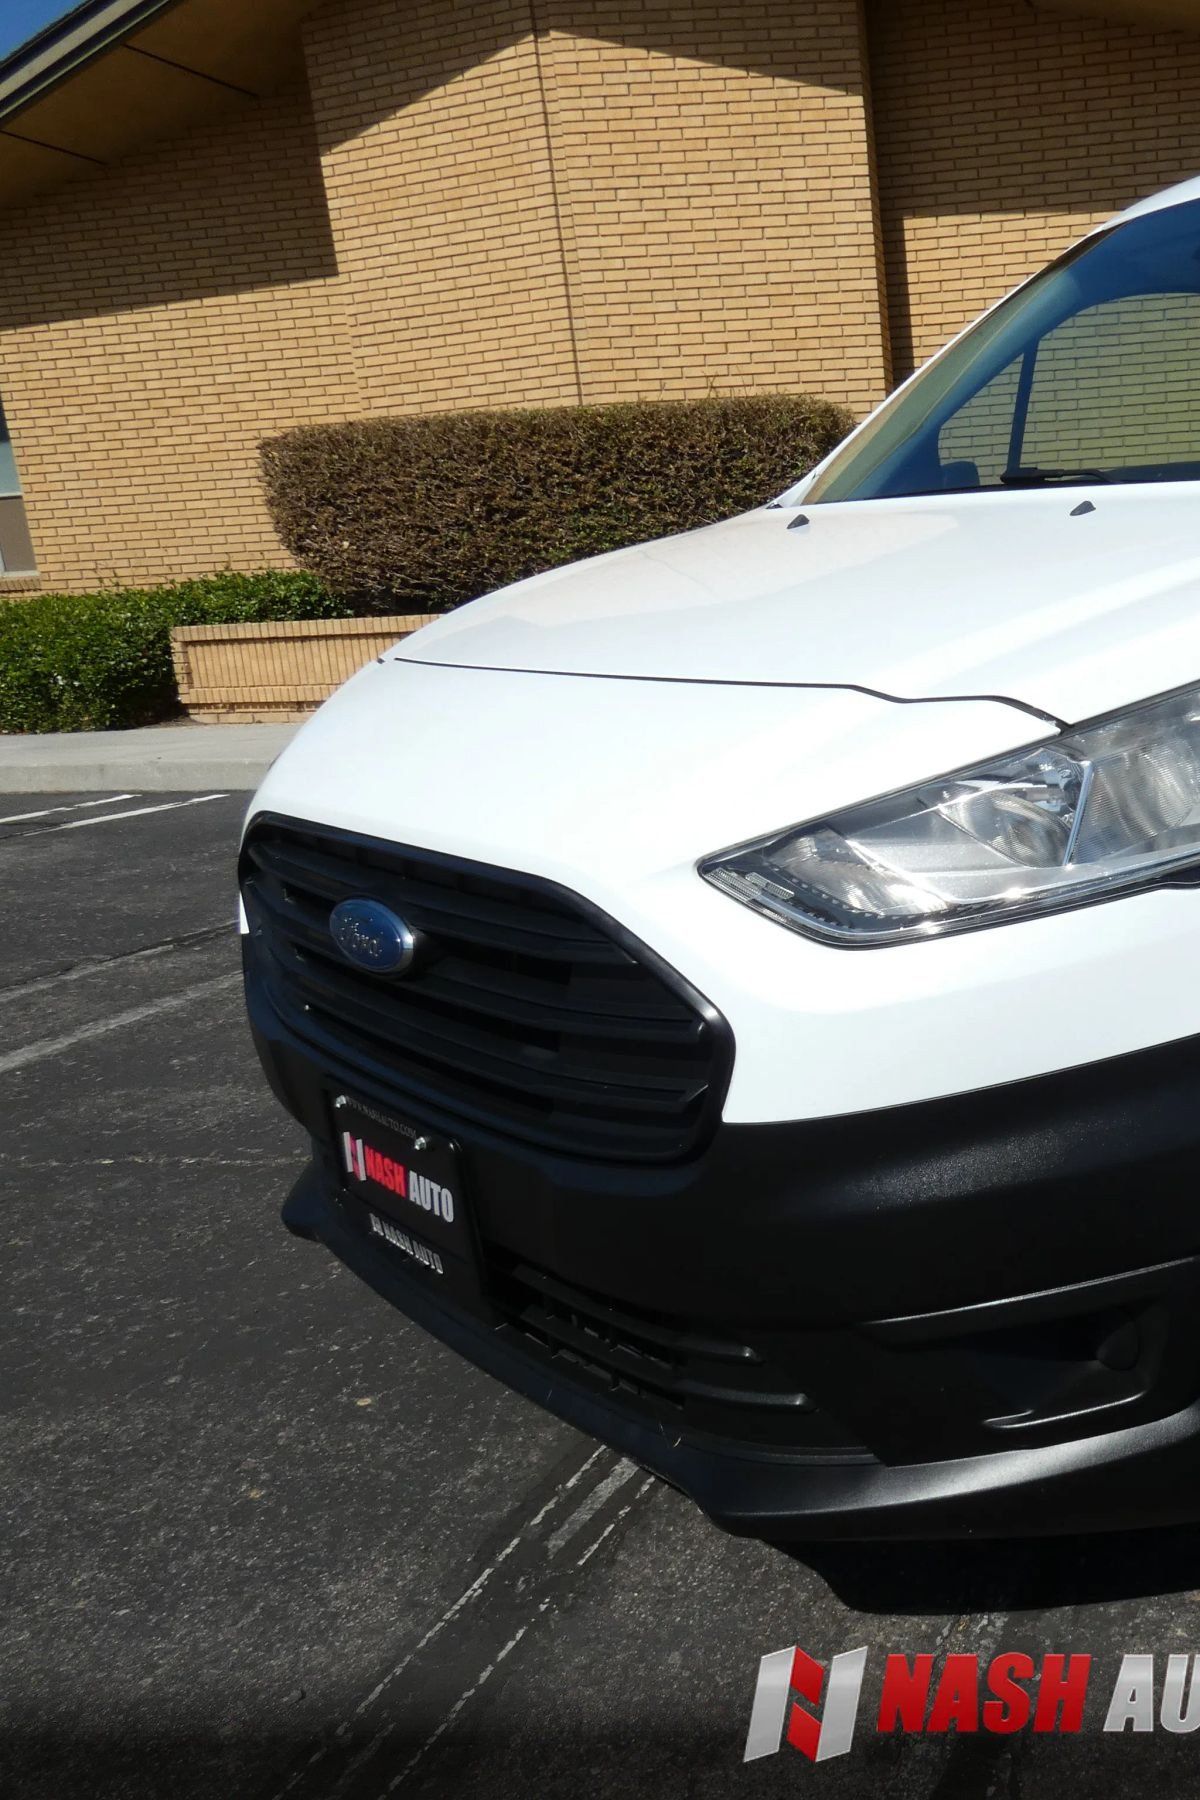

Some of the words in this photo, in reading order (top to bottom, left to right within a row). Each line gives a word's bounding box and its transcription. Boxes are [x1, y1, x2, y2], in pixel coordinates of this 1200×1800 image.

[364, 1144, 407, 1198] NASH
[409, 1169, 454, 1223] AUTO
[412, 1239, 444, 1275] AUTO
